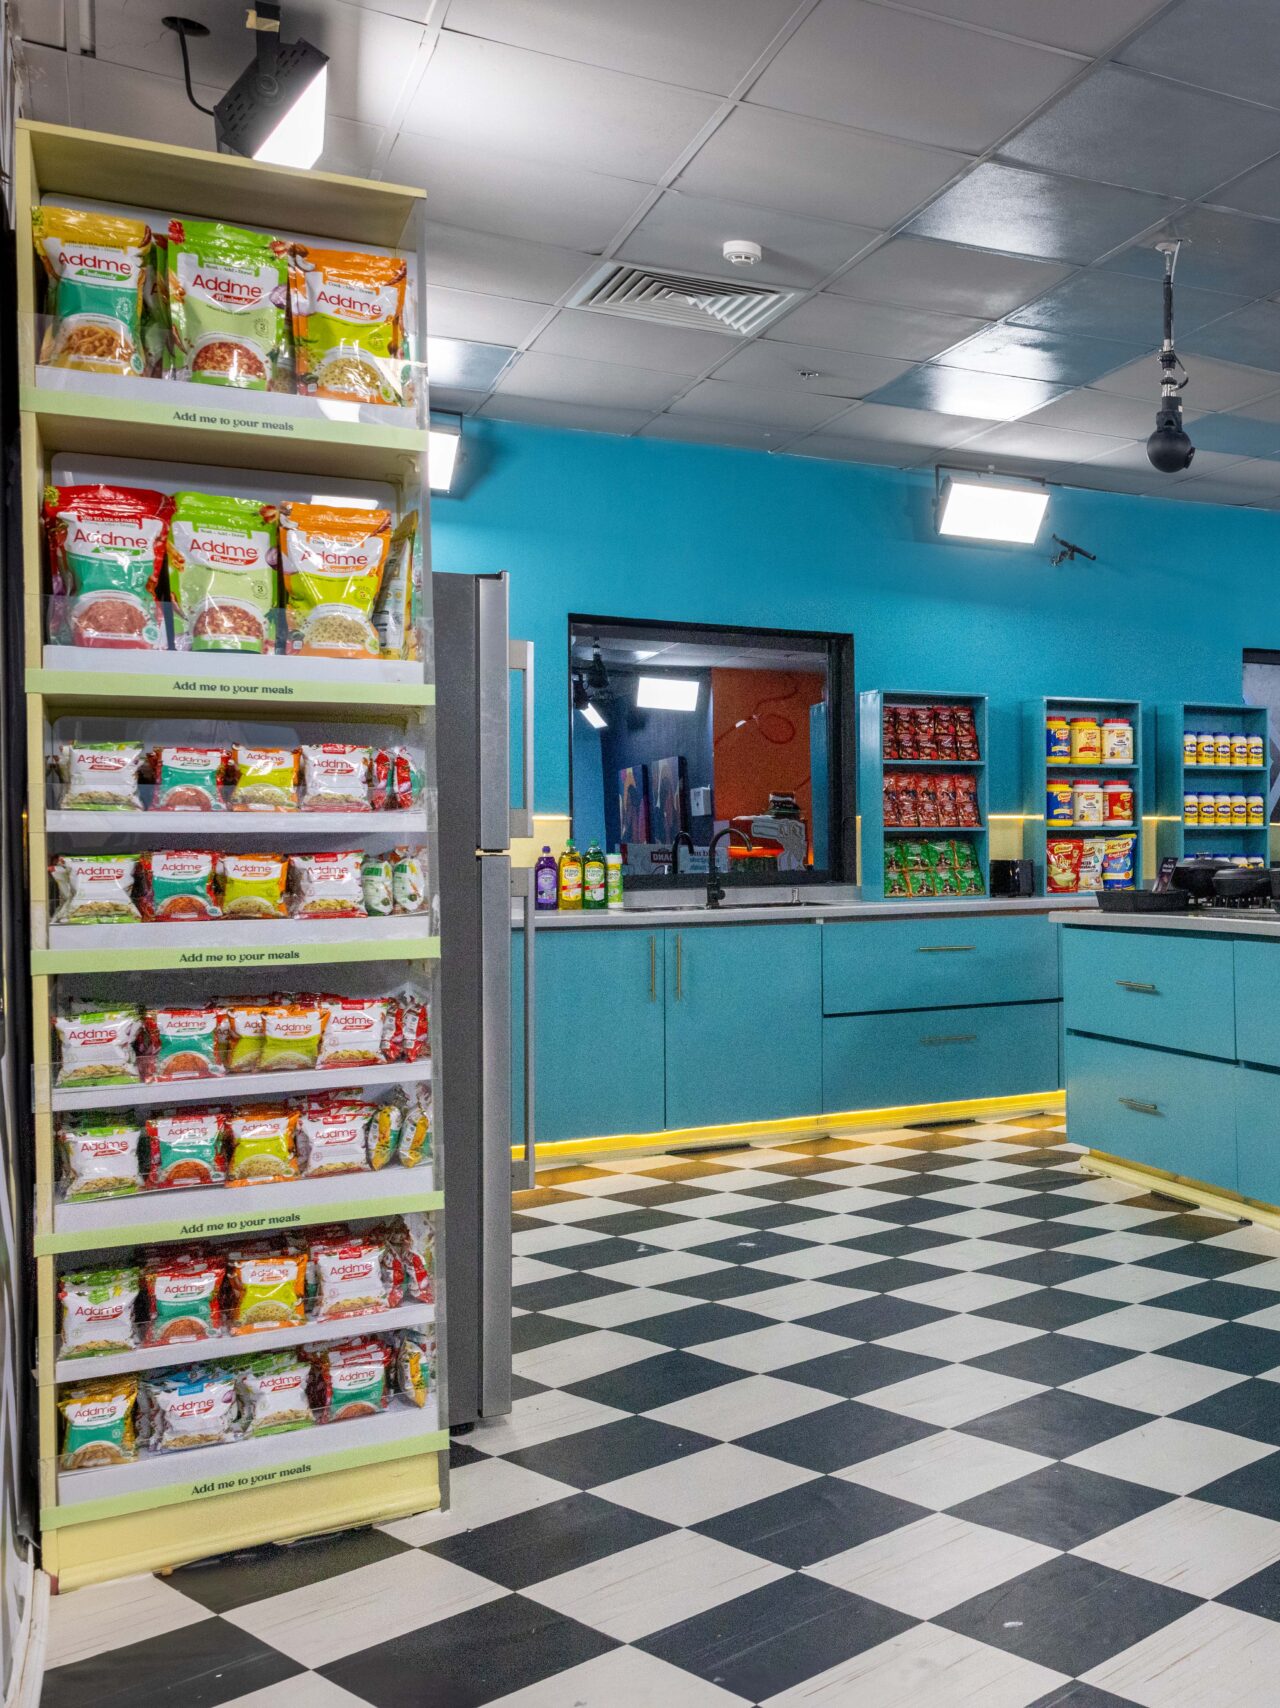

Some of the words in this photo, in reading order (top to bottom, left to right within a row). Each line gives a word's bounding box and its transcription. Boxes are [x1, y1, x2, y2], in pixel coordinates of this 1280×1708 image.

[59, 252, 132, 275] Addme
[192, 274, 262, 298] Addme
[316, 290, 382, 315] Addme
[173, 412, 196, 422] Add
[200, 414, 216, 424] me
[220, 416, 230, 425] to
[233, 420, 259, 428] your
[262, 422, 294, 431] meals
[189, 538, 258, 559] Addme
[257, 585, 263, 593] 3
[172, 682, 196, 690] Add
[232, 686, 258, 694] your
[261, 686, 294, 694] meals
[171, 754, 210, 764] Addme
[76, 866, 124, 876] Addme
[162, 864, 202, 872] Addme
[232, 864, 272, 873] Addme
[180, 954, 202, 962] Add
[226, 953, 236, 961] to
[239, 953, 265, 962] your
[268, 951, 300, 959] meals
[166, 1020, 206, 1028] Addme
[275, 1023, 312, 1032] Addme
[69, 1028, 117, 1040] Addme
[180, 1223, 204, 1234] Add
[207, 1223, 224, 1231] me
[227, 1221, 237, 1229] to
[240, 1218, 266, 1229] your
[268, 1213, 300, 1224] meals
[330, 1262, 374, 1275] Addme
[164, 1284, 204, 1294] Addme
[339, 1369, 375, 1382] Addme
[259, 1375, 301, 1389] Addme
[169, 1399, 214, 1412] Addme
[74, 1406, 117, 1418] Addme
[192, 1483, 215, 1495] Add
[217, 1480, 235, 1490] me
[251, 1472, 276, 1485] your
[280, 1464, 311, 1477] meals
